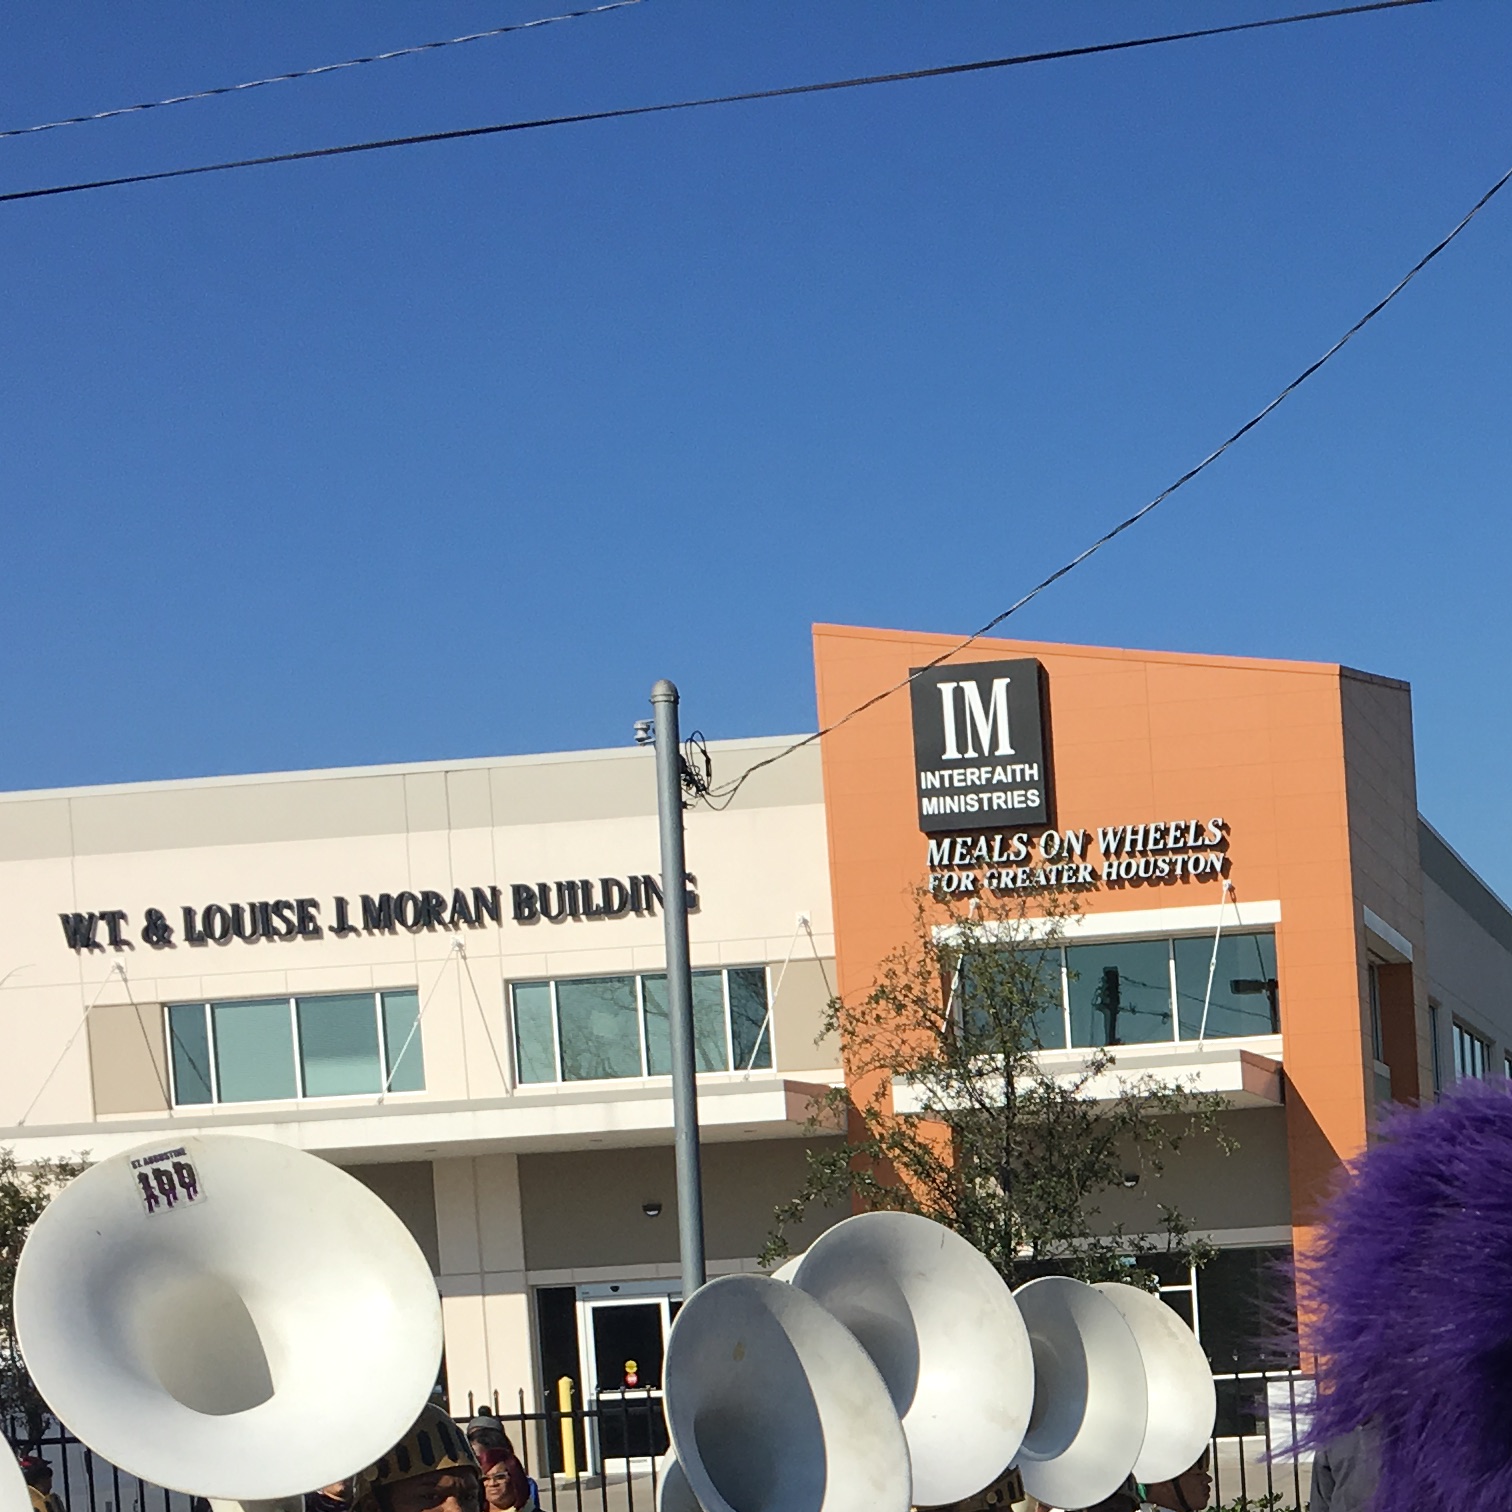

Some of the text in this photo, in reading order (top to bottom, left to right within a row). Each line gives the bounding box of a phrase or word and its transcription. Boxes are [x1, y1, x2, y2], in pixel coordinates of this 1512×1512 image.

[937, 677, 1016, 760] IM
[920, 763, 1039, 789] INTERFAITH
[922, 790, 1041, 816] MINISTRIES
[926, 817, 1225, 867] MEALS ON WHEELS
[928, 851, 1225, 894] FOR GREATER HOUSTON
[141, 907, 173, 948] &
[181, 897, 323, 945] LOUISE
[360, 885, 503, 932] MORAN
